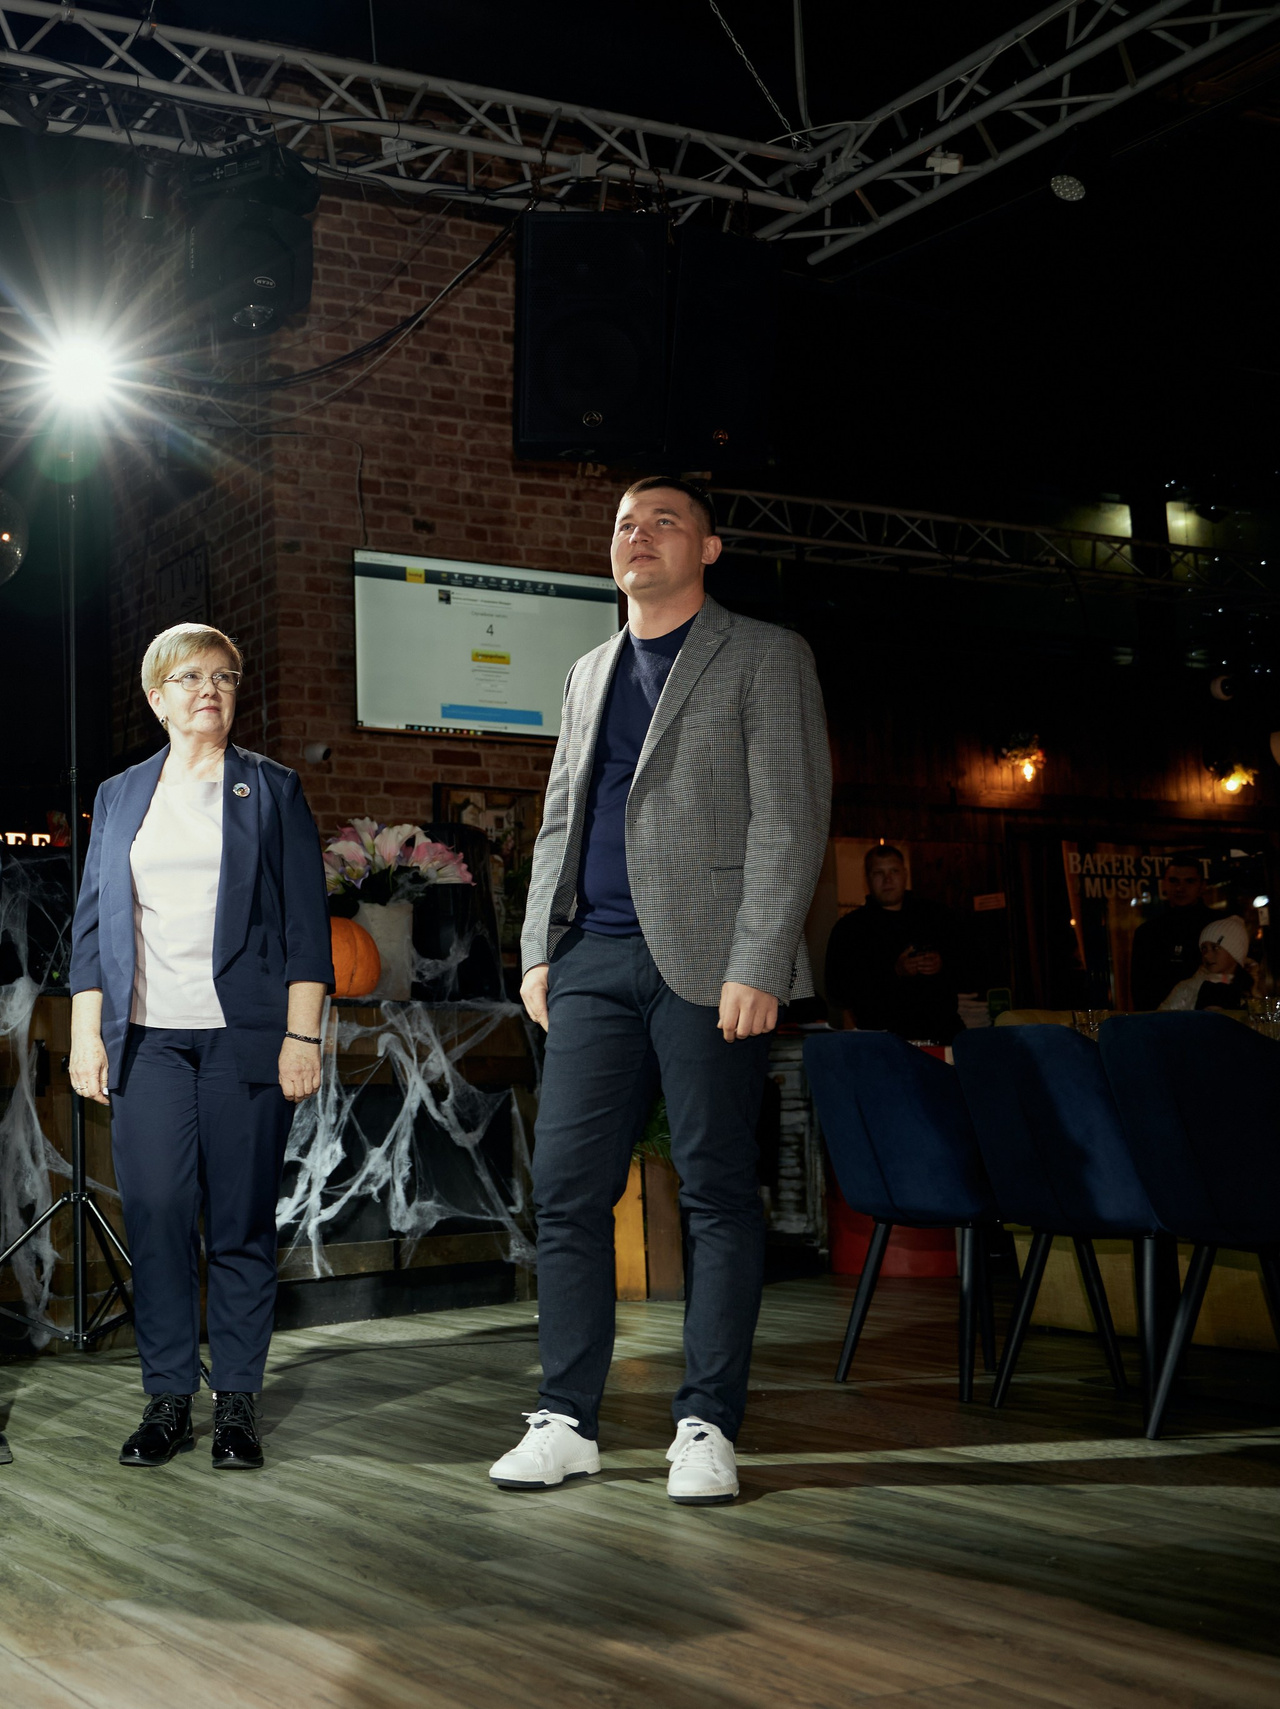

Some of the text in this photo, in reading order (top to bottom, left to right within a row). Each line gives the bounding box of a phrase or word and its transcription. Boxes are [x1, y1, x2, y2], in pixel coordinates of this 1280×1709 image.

[486, 624, 494, 636] 4
[1068, 851, 1137, 877] BAKER
[1084, 876, 1151, 900] MUSIC
